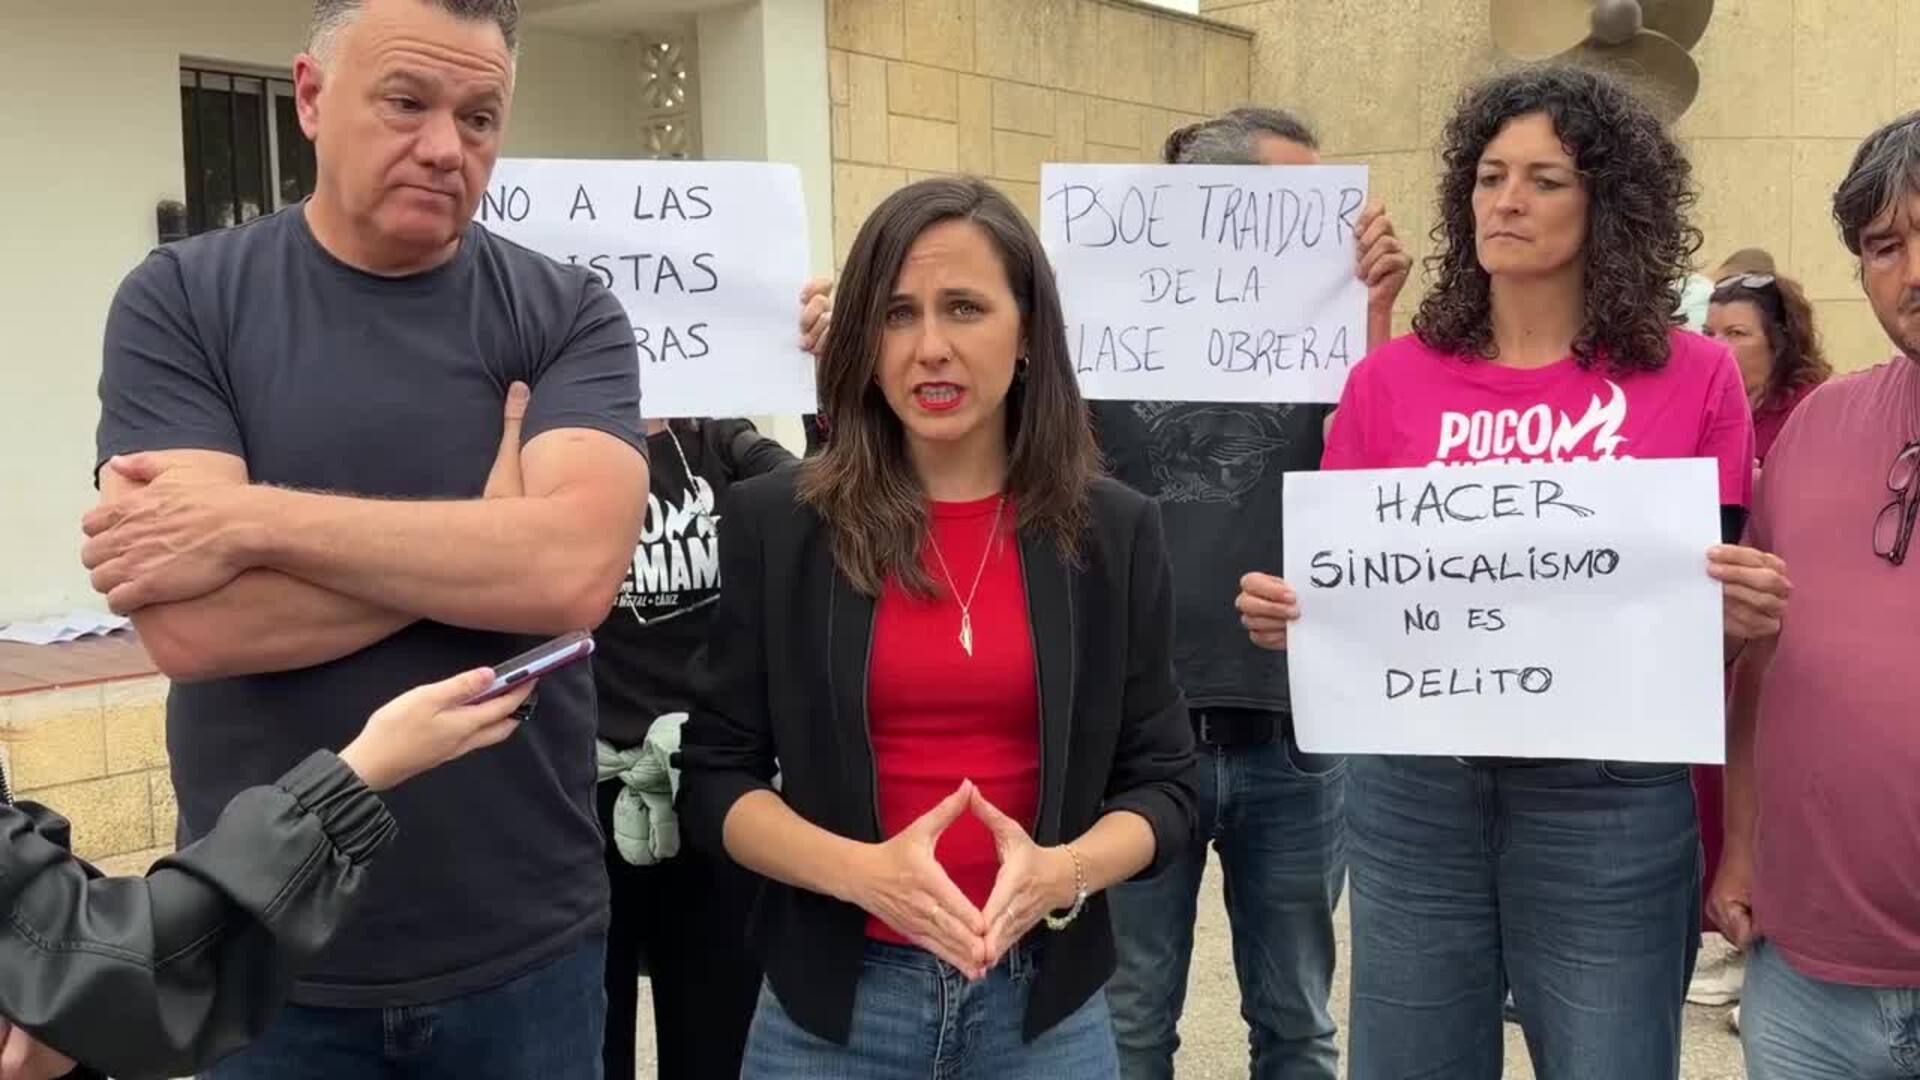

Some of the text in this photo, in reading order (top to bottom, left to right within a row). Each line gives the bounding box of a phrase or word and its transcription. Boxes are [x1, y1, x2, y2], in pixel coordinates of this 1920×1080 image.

[481, 184, 713, 222] NO A LAS
[1047, 183, 1364, 257] PSOE TRAIDOR
[568, 253, 718, 294] STAS
[1140, 265, 1269, 304] DE LA
[633, 322, 709, 363] RAS
[1063, 324, 1351, 376] LASE OBRERA
[1436, 403, 1553, 460] POCO
[1376, 479, 1595, 526] HACER
[1404, 603, 1507, 635] NO ES
